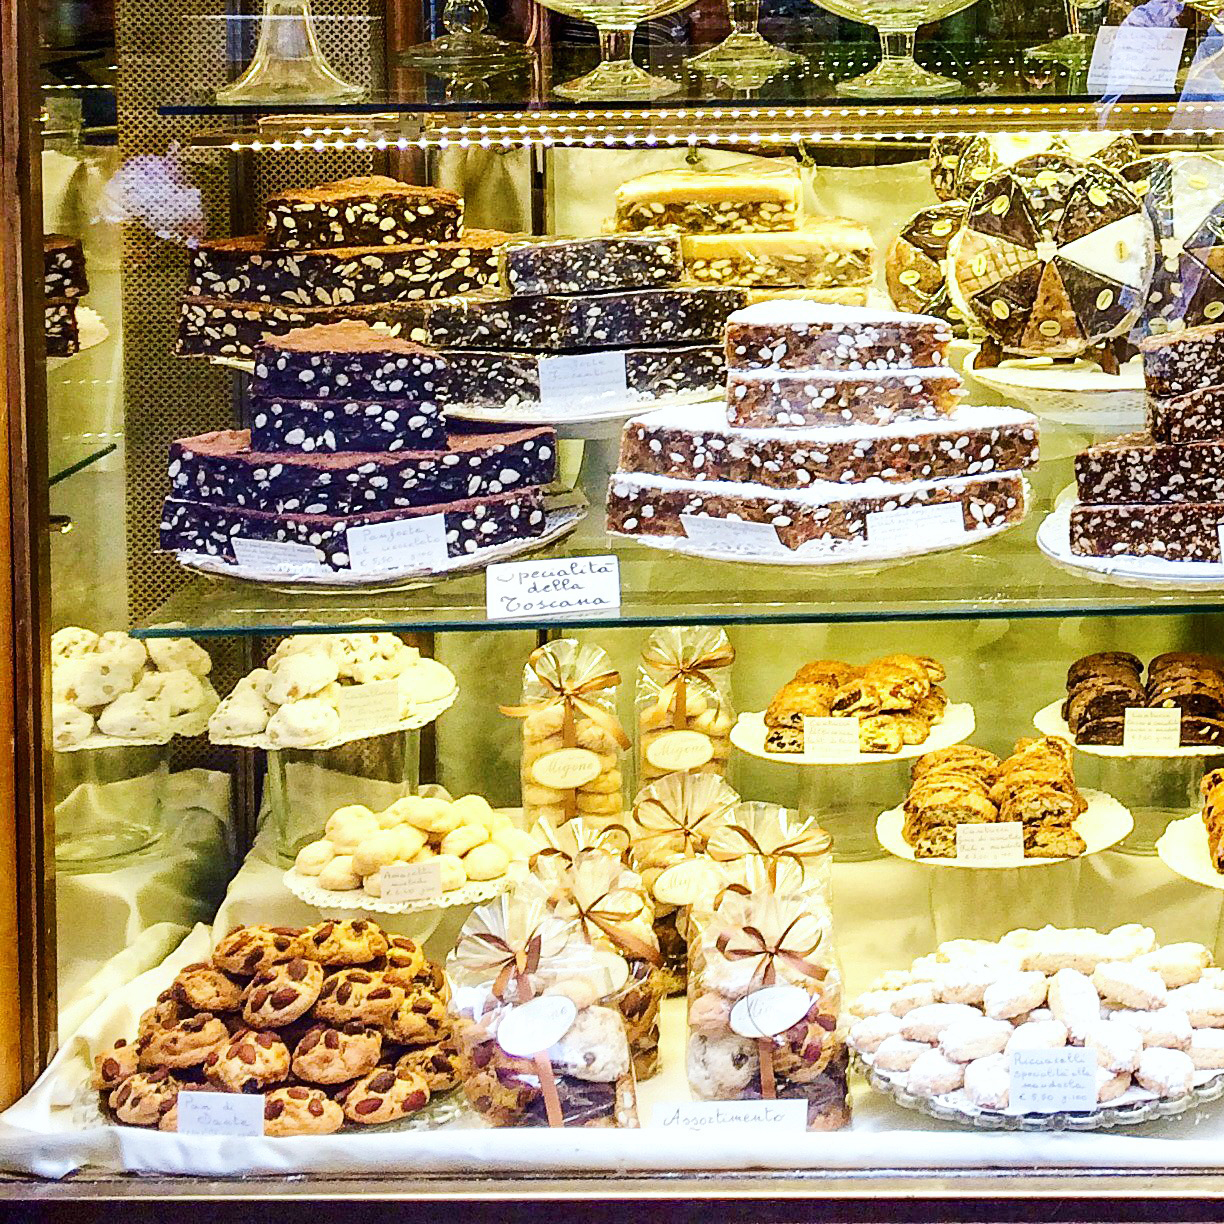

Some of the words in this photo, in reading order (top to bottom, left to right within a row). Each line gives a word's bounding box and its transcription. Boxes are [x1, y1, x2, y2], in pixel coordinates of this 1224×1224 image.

[527, 578, 587, 594] della
[500, 595, 612, 613] Toscana
[663, 1107, 787, 1128] Assortimento
